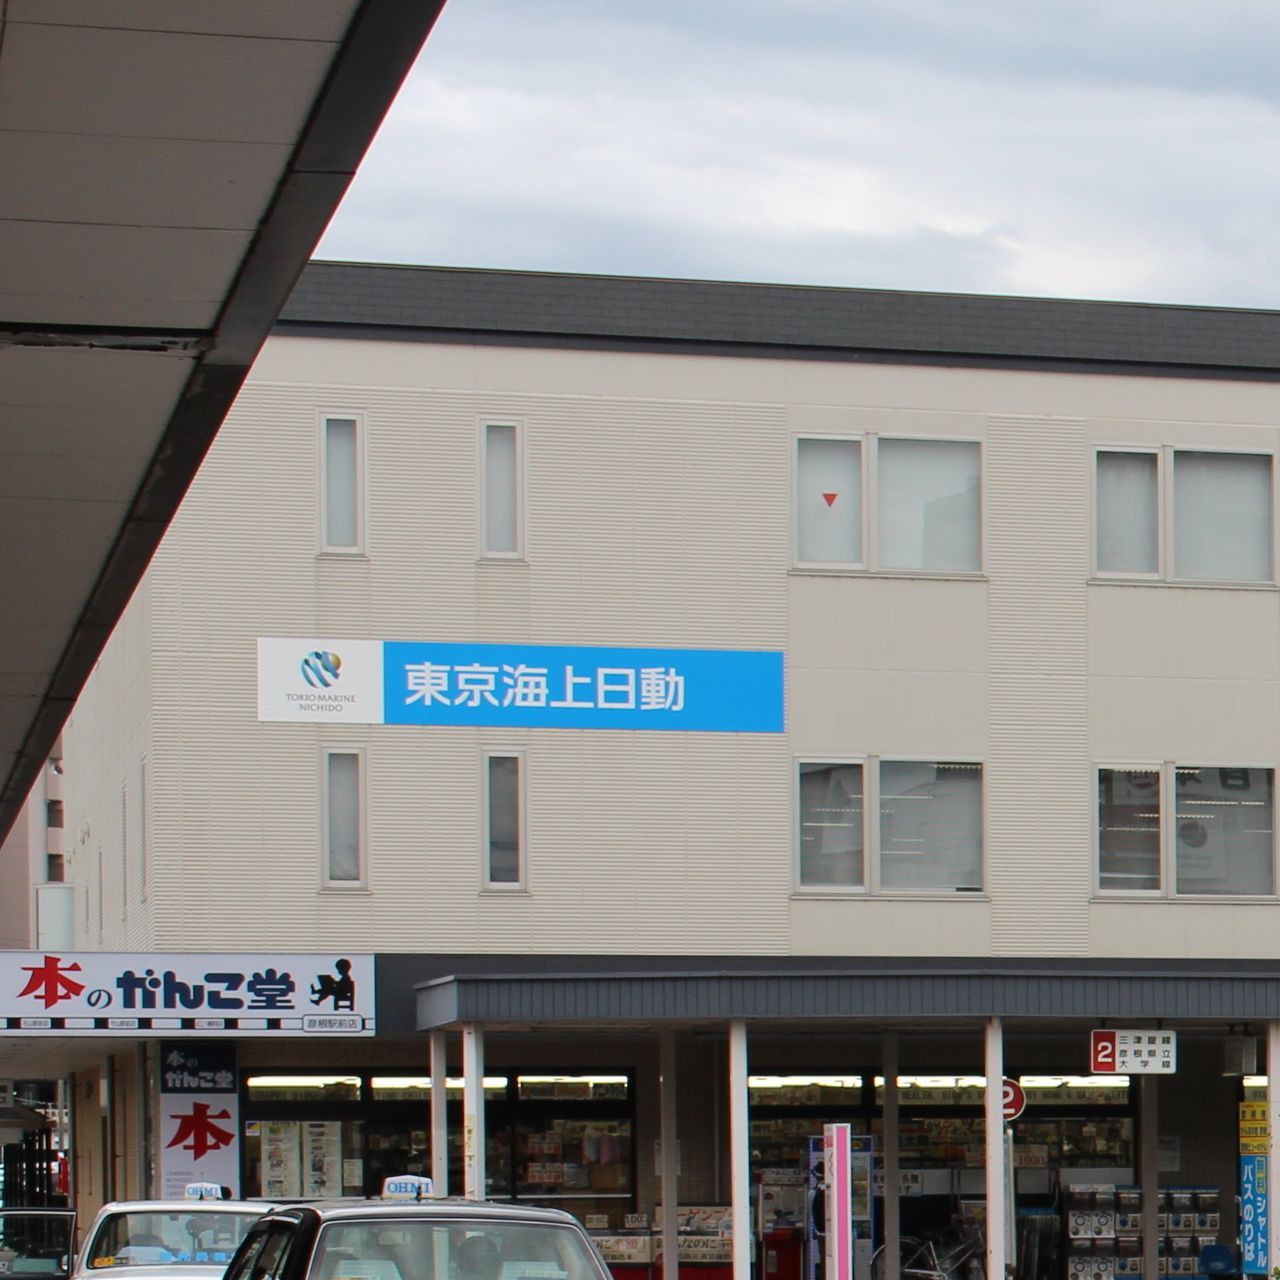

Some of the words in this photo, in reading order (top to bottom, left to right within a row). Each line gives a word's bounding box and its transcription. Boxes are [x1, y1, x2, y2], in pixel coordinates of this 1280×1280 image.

[404, 661, 686, 712] 東京海上日動
[286, 692, 318, 703] TOKIO
[319, 693, 357, 704] MARINE
[299, 702, 344, 713] NICHIDO
[16, 954, 296, 1010] 本のがんこ堂
[307, 1017, 359, 1029] 彦根駅前店
[1097, 1041, 1113, 1063] 2
[1119, 1060, 1171, 1069] 大学線
[165, 1070, 234, 1089] がんこ堂
[165, 1100, 236, 1163] 本
[387, 1182, 430, 1194] OHMI
[1243, 1164, 1255, 1262] バスのりば
[1256, 1196, 1267, 1268] シャトル
